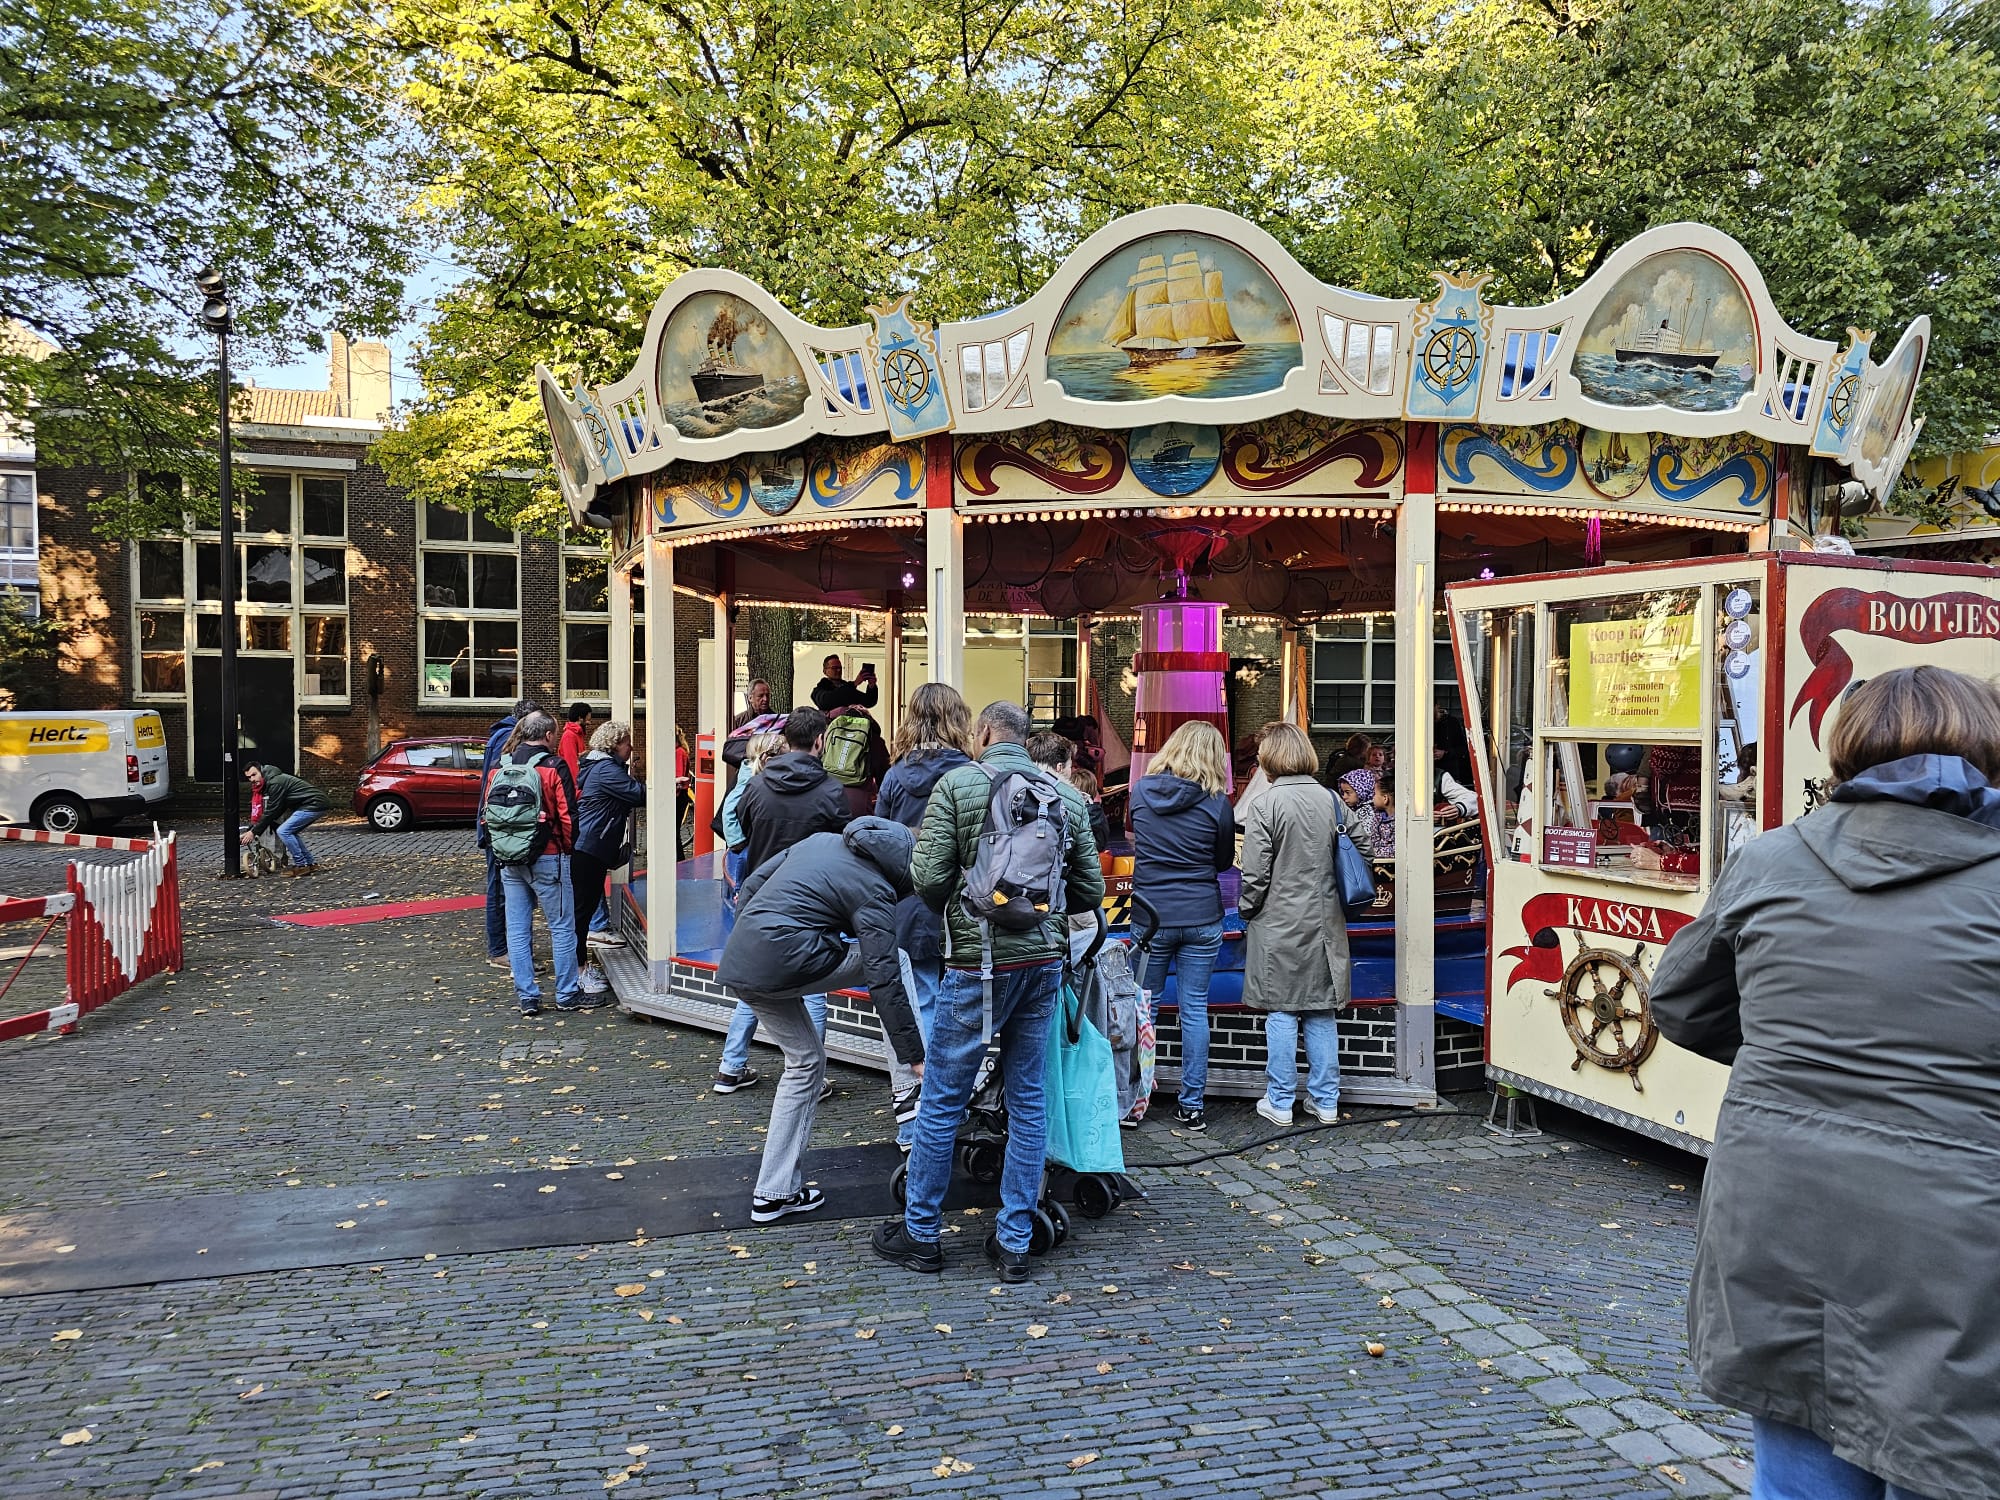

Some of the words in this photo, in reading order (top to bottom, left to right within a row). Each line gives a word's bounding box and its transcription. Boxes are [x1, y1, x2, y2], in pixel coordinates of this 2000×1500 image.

[1868, 600, 2000, 635] BOOTJES
[29, 725, 90, 742] Hertz
[137, 725, 154, 738] Hertz
[1544, 828, 1595, 838] BOOTJESMOLEN
[1566, 897, 1665, 940] KASSA
